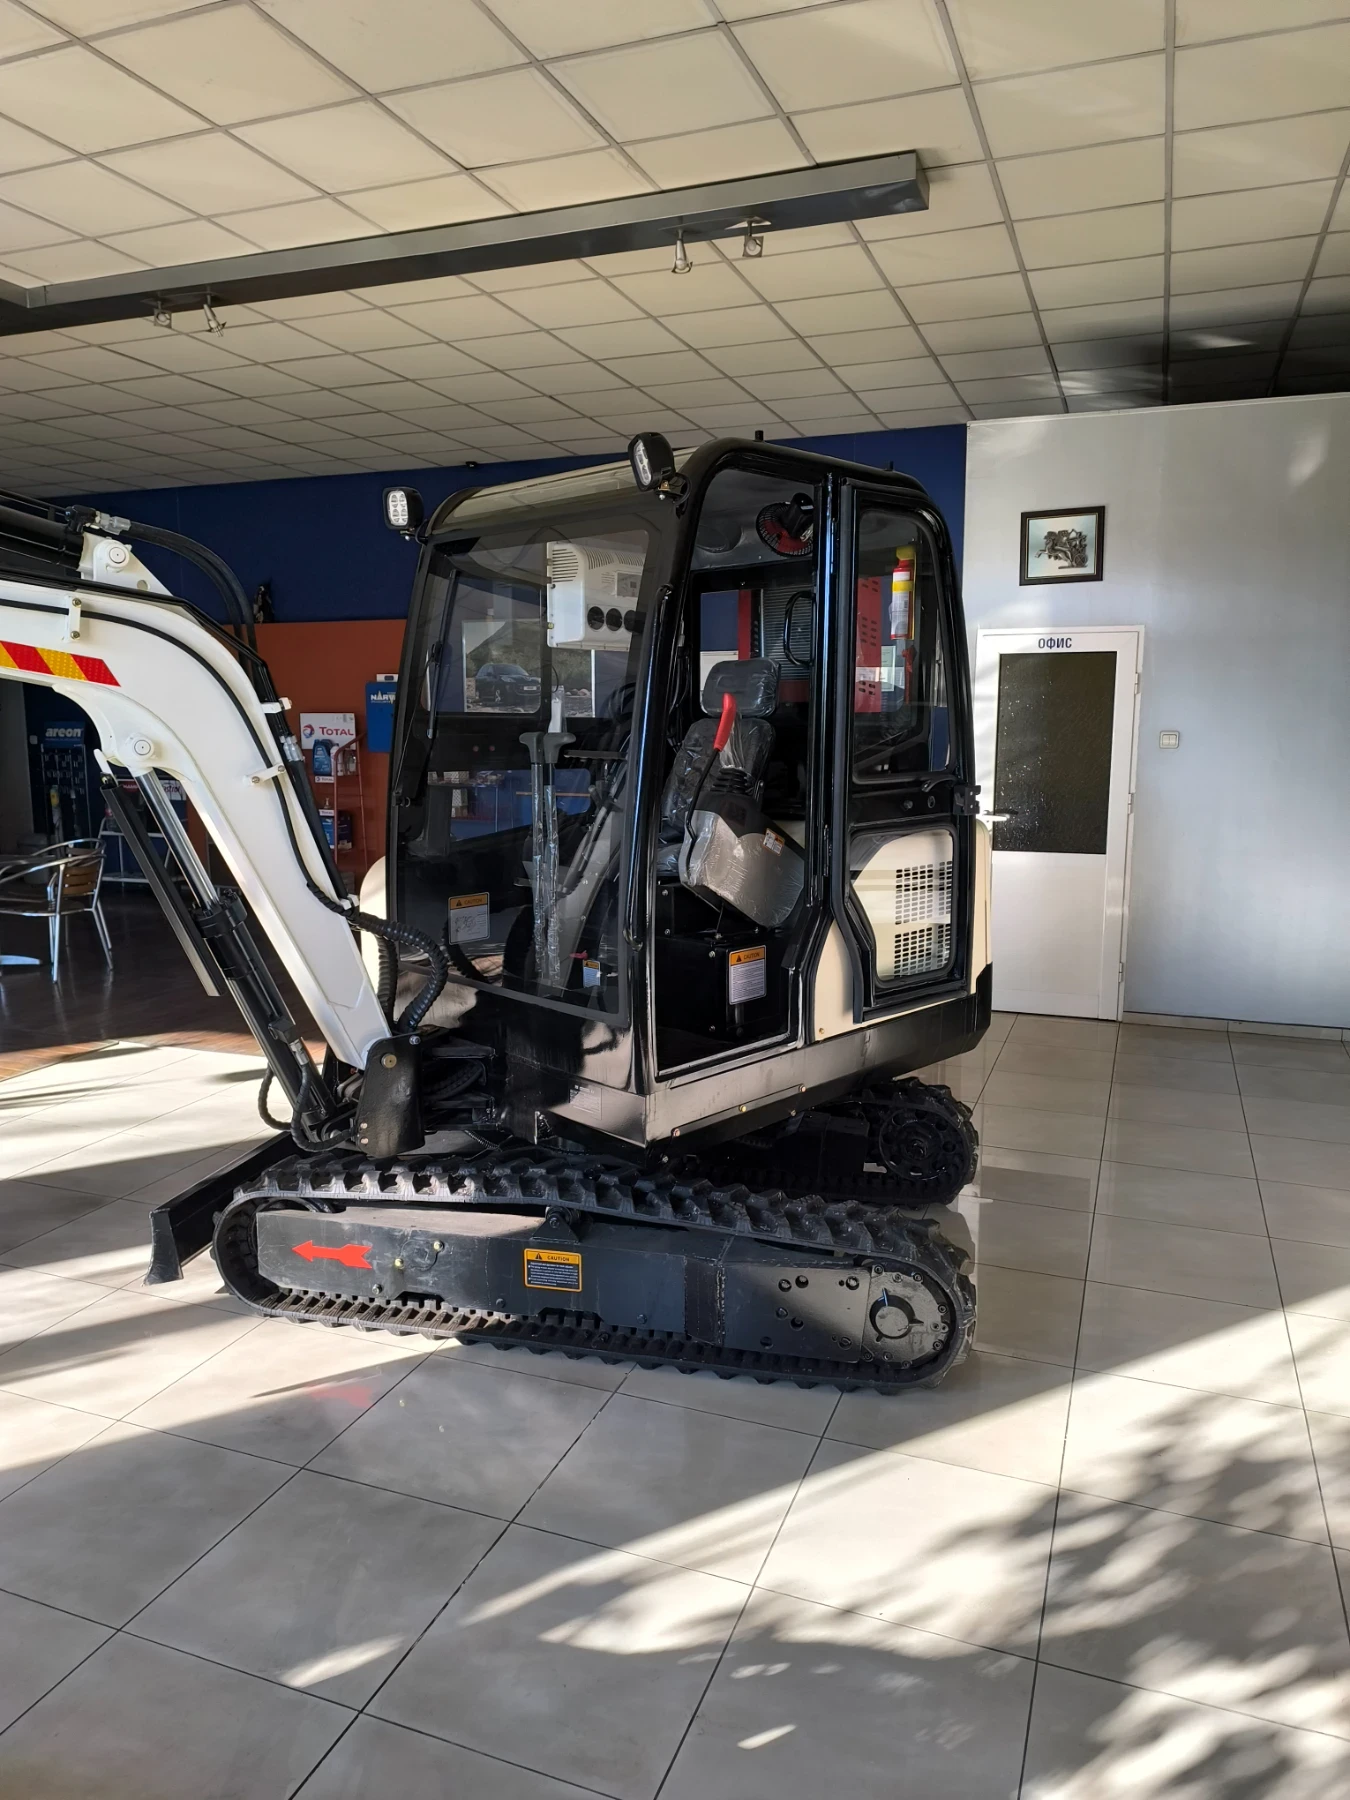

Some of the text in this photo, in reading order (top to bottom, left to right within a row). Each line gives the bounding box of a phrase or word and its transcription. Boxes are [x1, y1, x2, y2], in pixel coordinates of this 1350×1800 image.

[1038, 637, 1072, 649] ОФИС
[370, 690, 396, 704] NARV
[45, 728, 81, 738] areon
[319, 726, 354, 736] TOTAL
[743, 952, 760, 960] CAUTION
